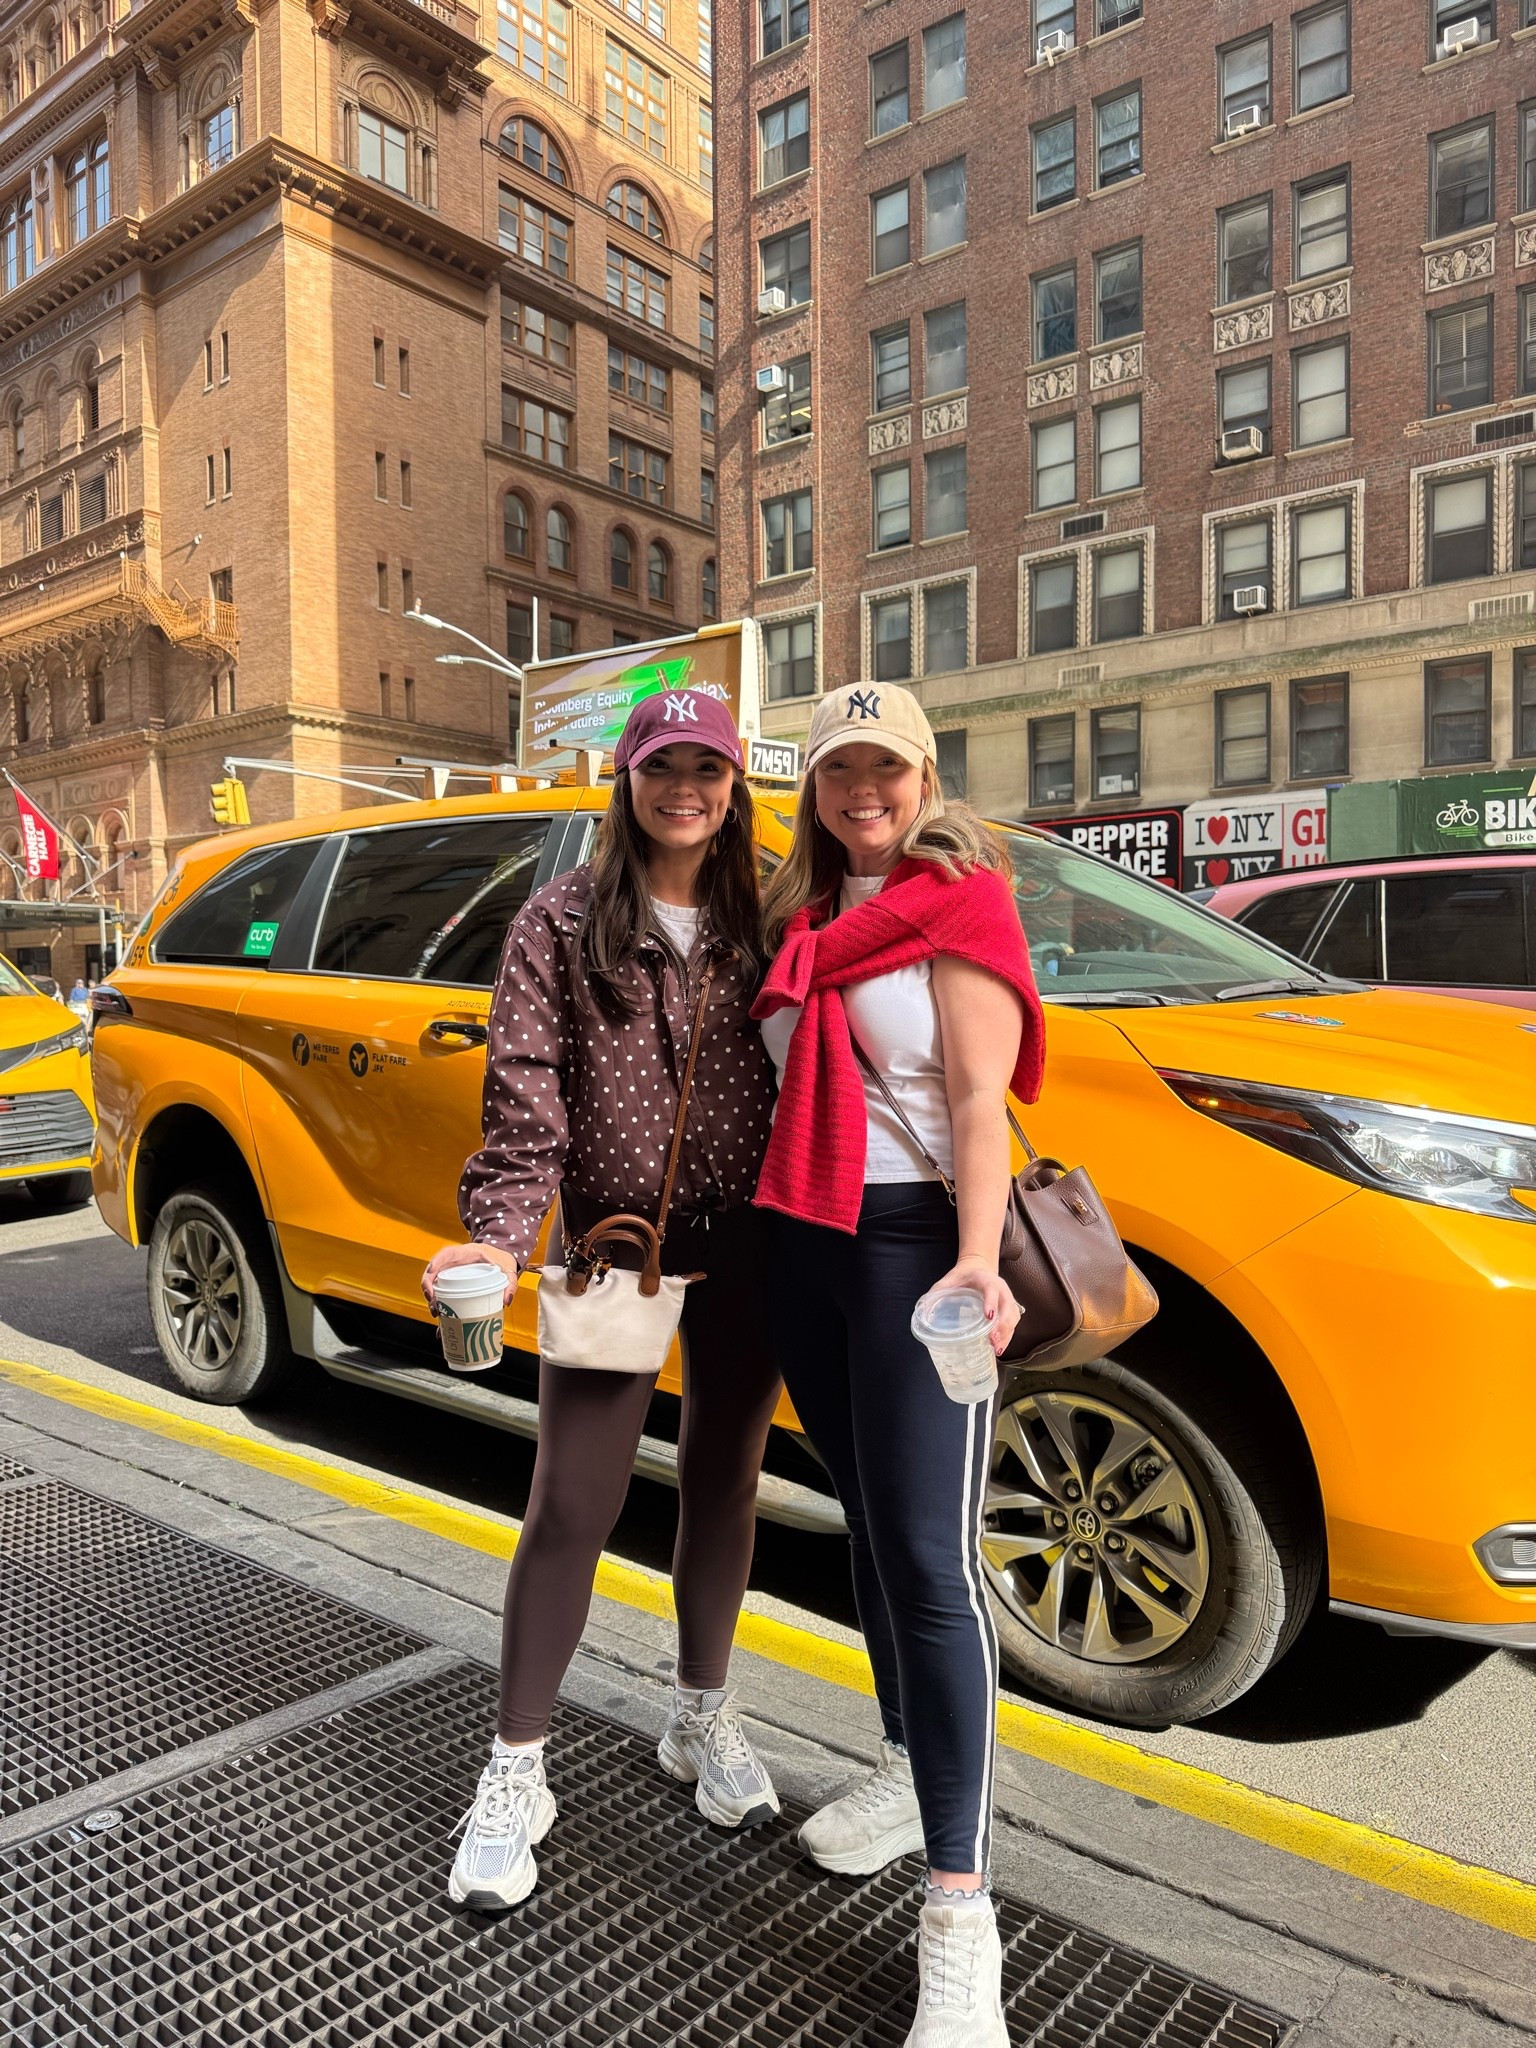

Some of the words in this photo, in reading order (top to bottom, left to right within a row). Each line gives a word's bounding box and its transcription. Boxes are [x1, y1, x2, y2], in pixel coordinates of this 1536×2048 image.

[597, 690, 633, 708] Equity
[663, 693, 699, 722] NY
[847, 689, 881, 720] NY
[753, 746, 792, 775] 7M59
[1072, 820, 1169, 852] PEPPER
[1231, 812, 1275, 843] NY
[22, 813, 41, 876] CARNEGIE
[36, 828, 49, 861] HALL
[1505, 833, 1534, 843] Bike
[250, 927, 274, 941] curb
[446, 1000, 484, 1010] AUTOMATIC
[313, 1043, 340, 1055] METERED
[313, 1053, 328, 1063] FARE
[372, 1053, 388, 1064] FLAT
[389, 1055, 407, 1066] FARE
[372, 1064, 384, 1074] JFK
